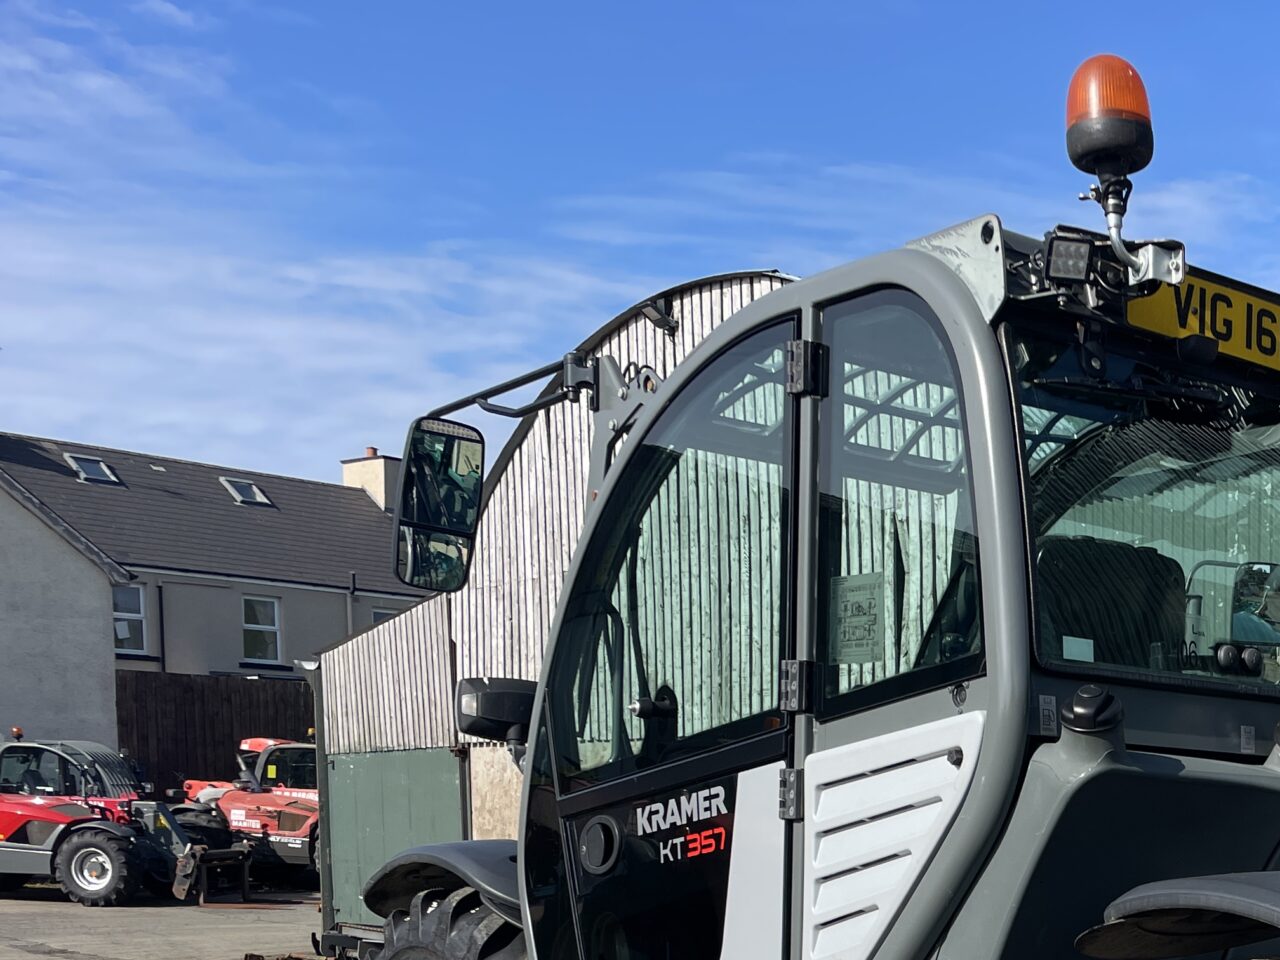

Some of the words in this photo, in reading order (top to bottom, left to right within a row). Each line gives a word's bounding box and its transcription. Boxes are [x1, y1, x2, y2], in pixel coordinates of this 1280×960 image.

[1171, 283, 1233, 342] VIG
[636, 785, 728, 836] KRAMER
[659, 827, 726, 864] KT357
